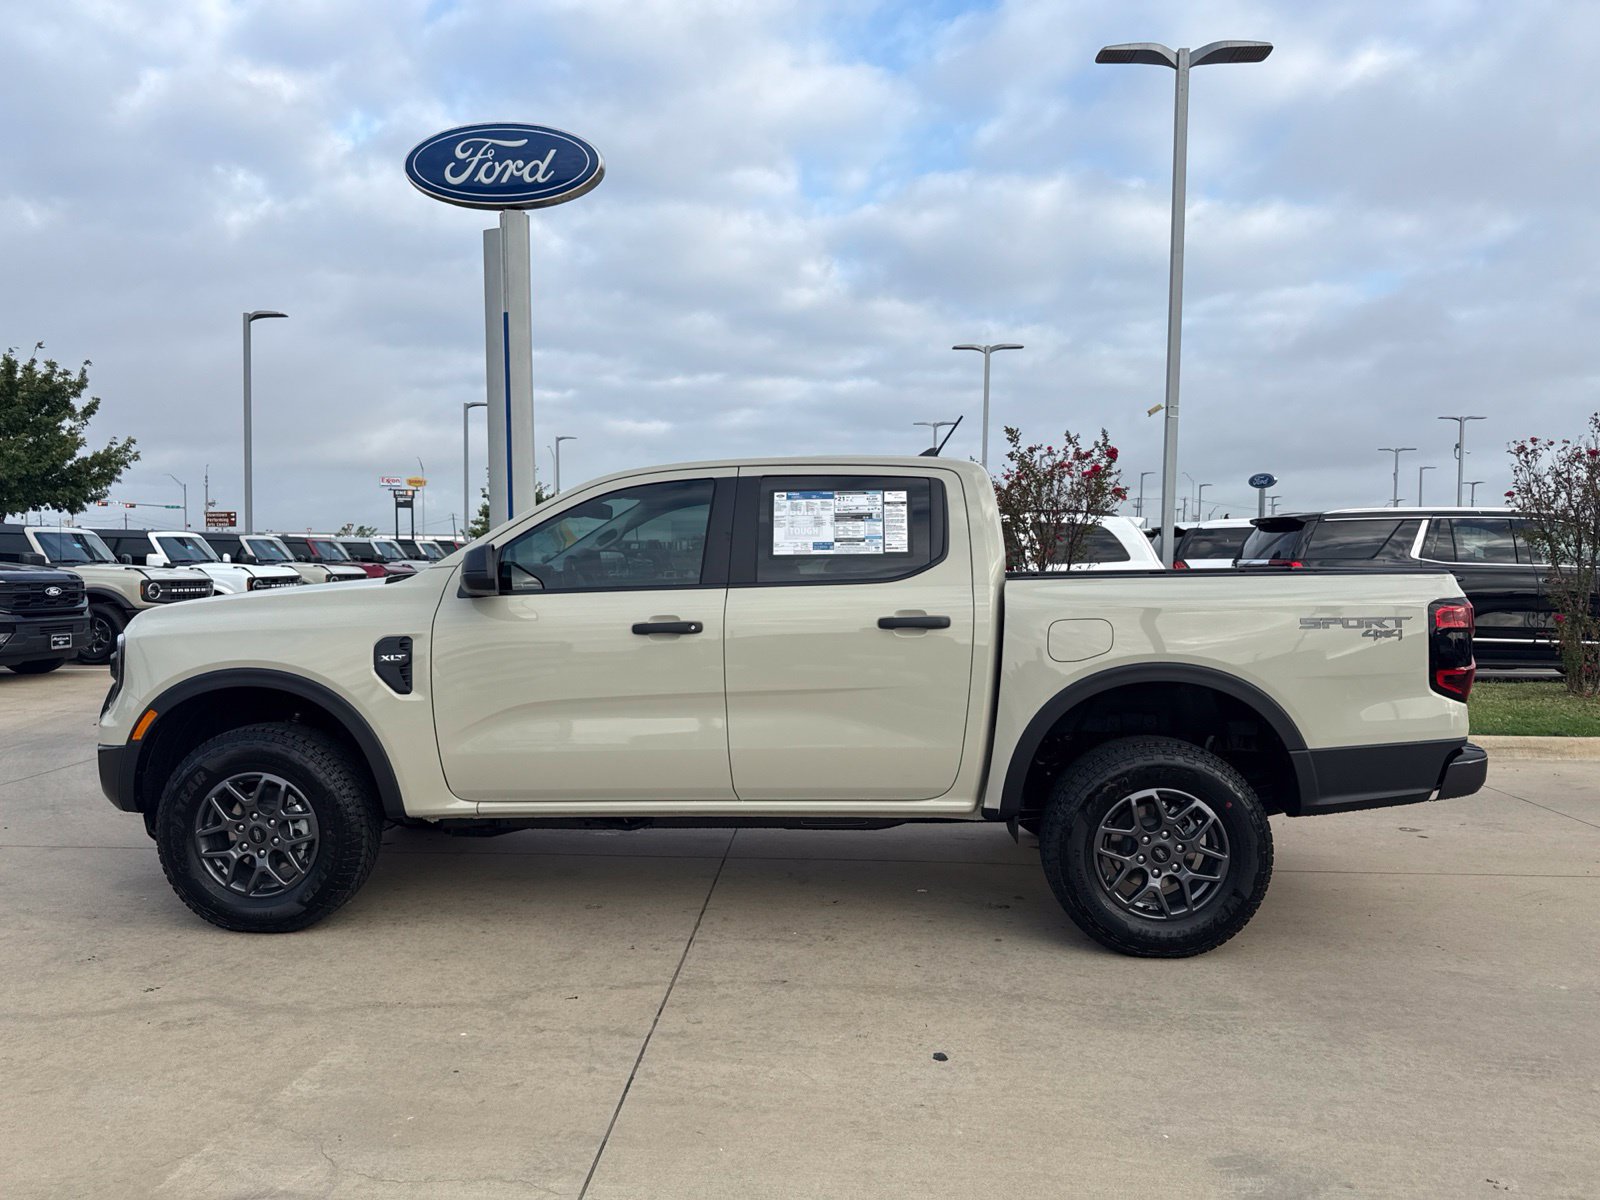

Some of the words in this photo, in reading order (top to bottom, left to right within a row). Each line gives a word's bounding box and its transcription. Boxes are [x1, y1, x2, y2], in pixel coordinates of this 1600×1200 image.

[444, 138, 557, 185] Ford
[1299, 616, 1412, 629] SPORT
[380, 654, 407, 662] XLT
